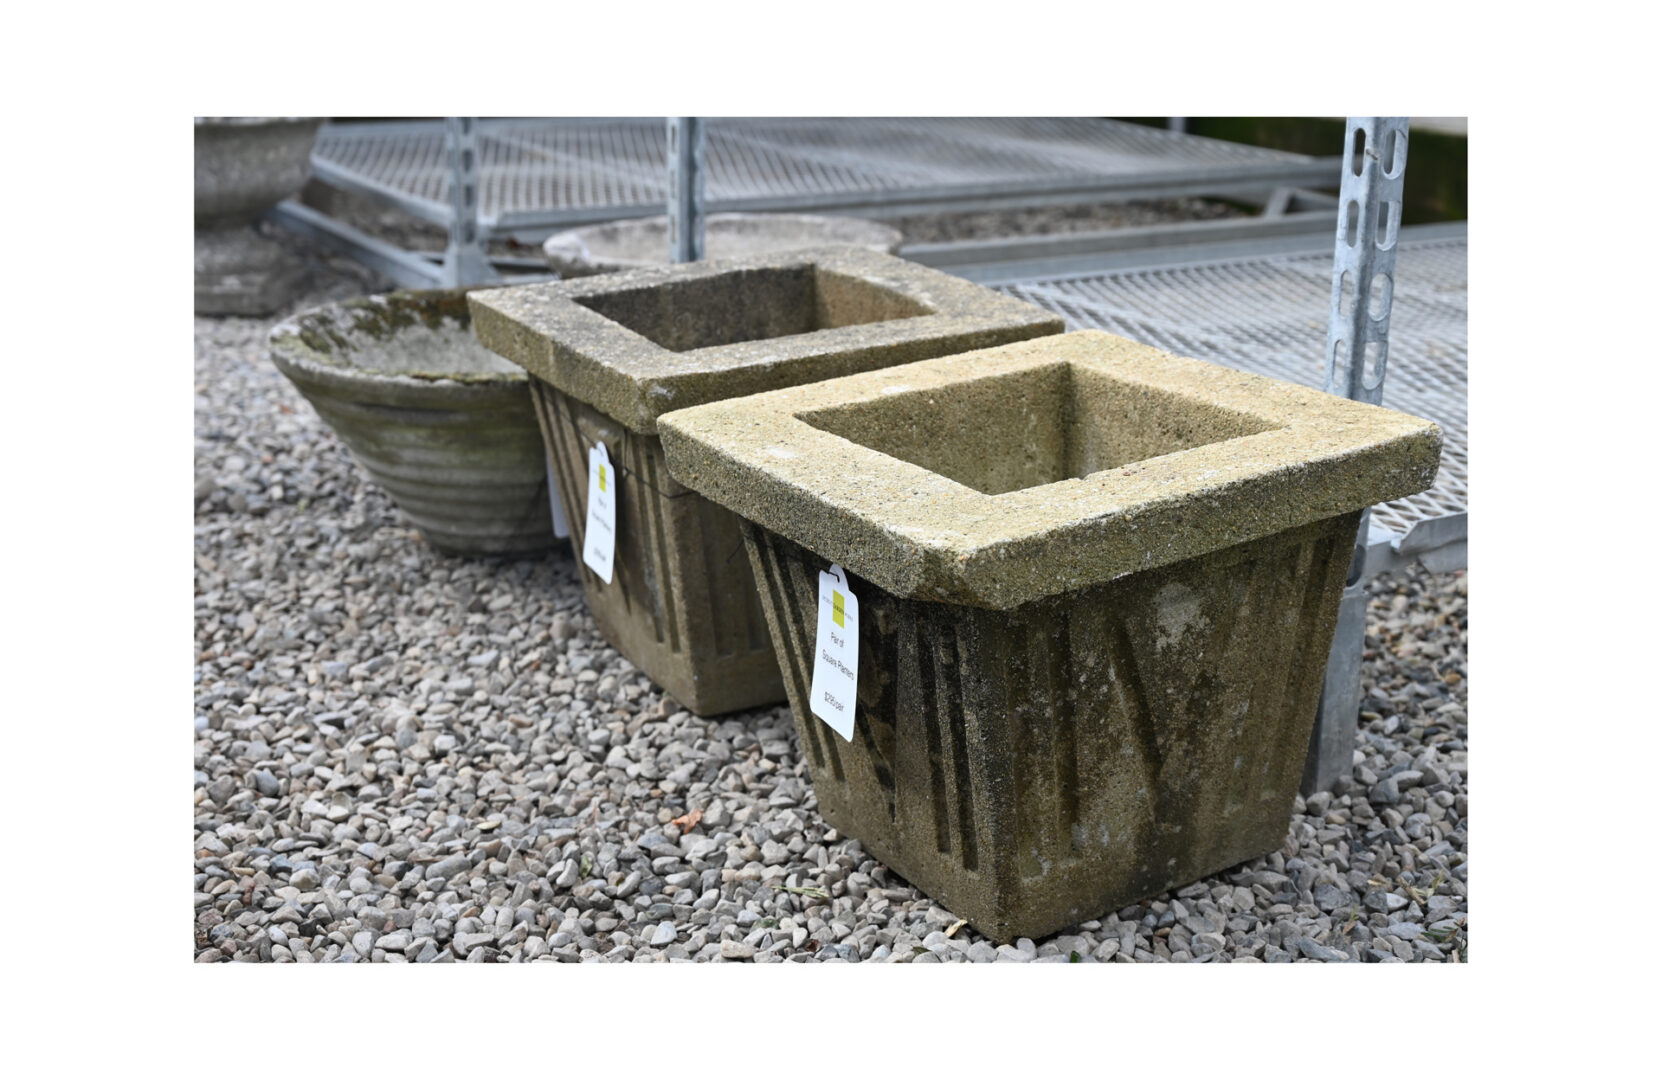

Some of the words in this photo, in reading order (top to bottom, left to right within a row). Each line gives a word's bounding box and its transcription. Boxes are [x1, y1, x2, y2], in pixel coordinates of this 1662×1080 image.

[831, 631, 839, 645] Pair
[822, 649, 837, 668] Square
[837, 660, 854, 681] Planters
